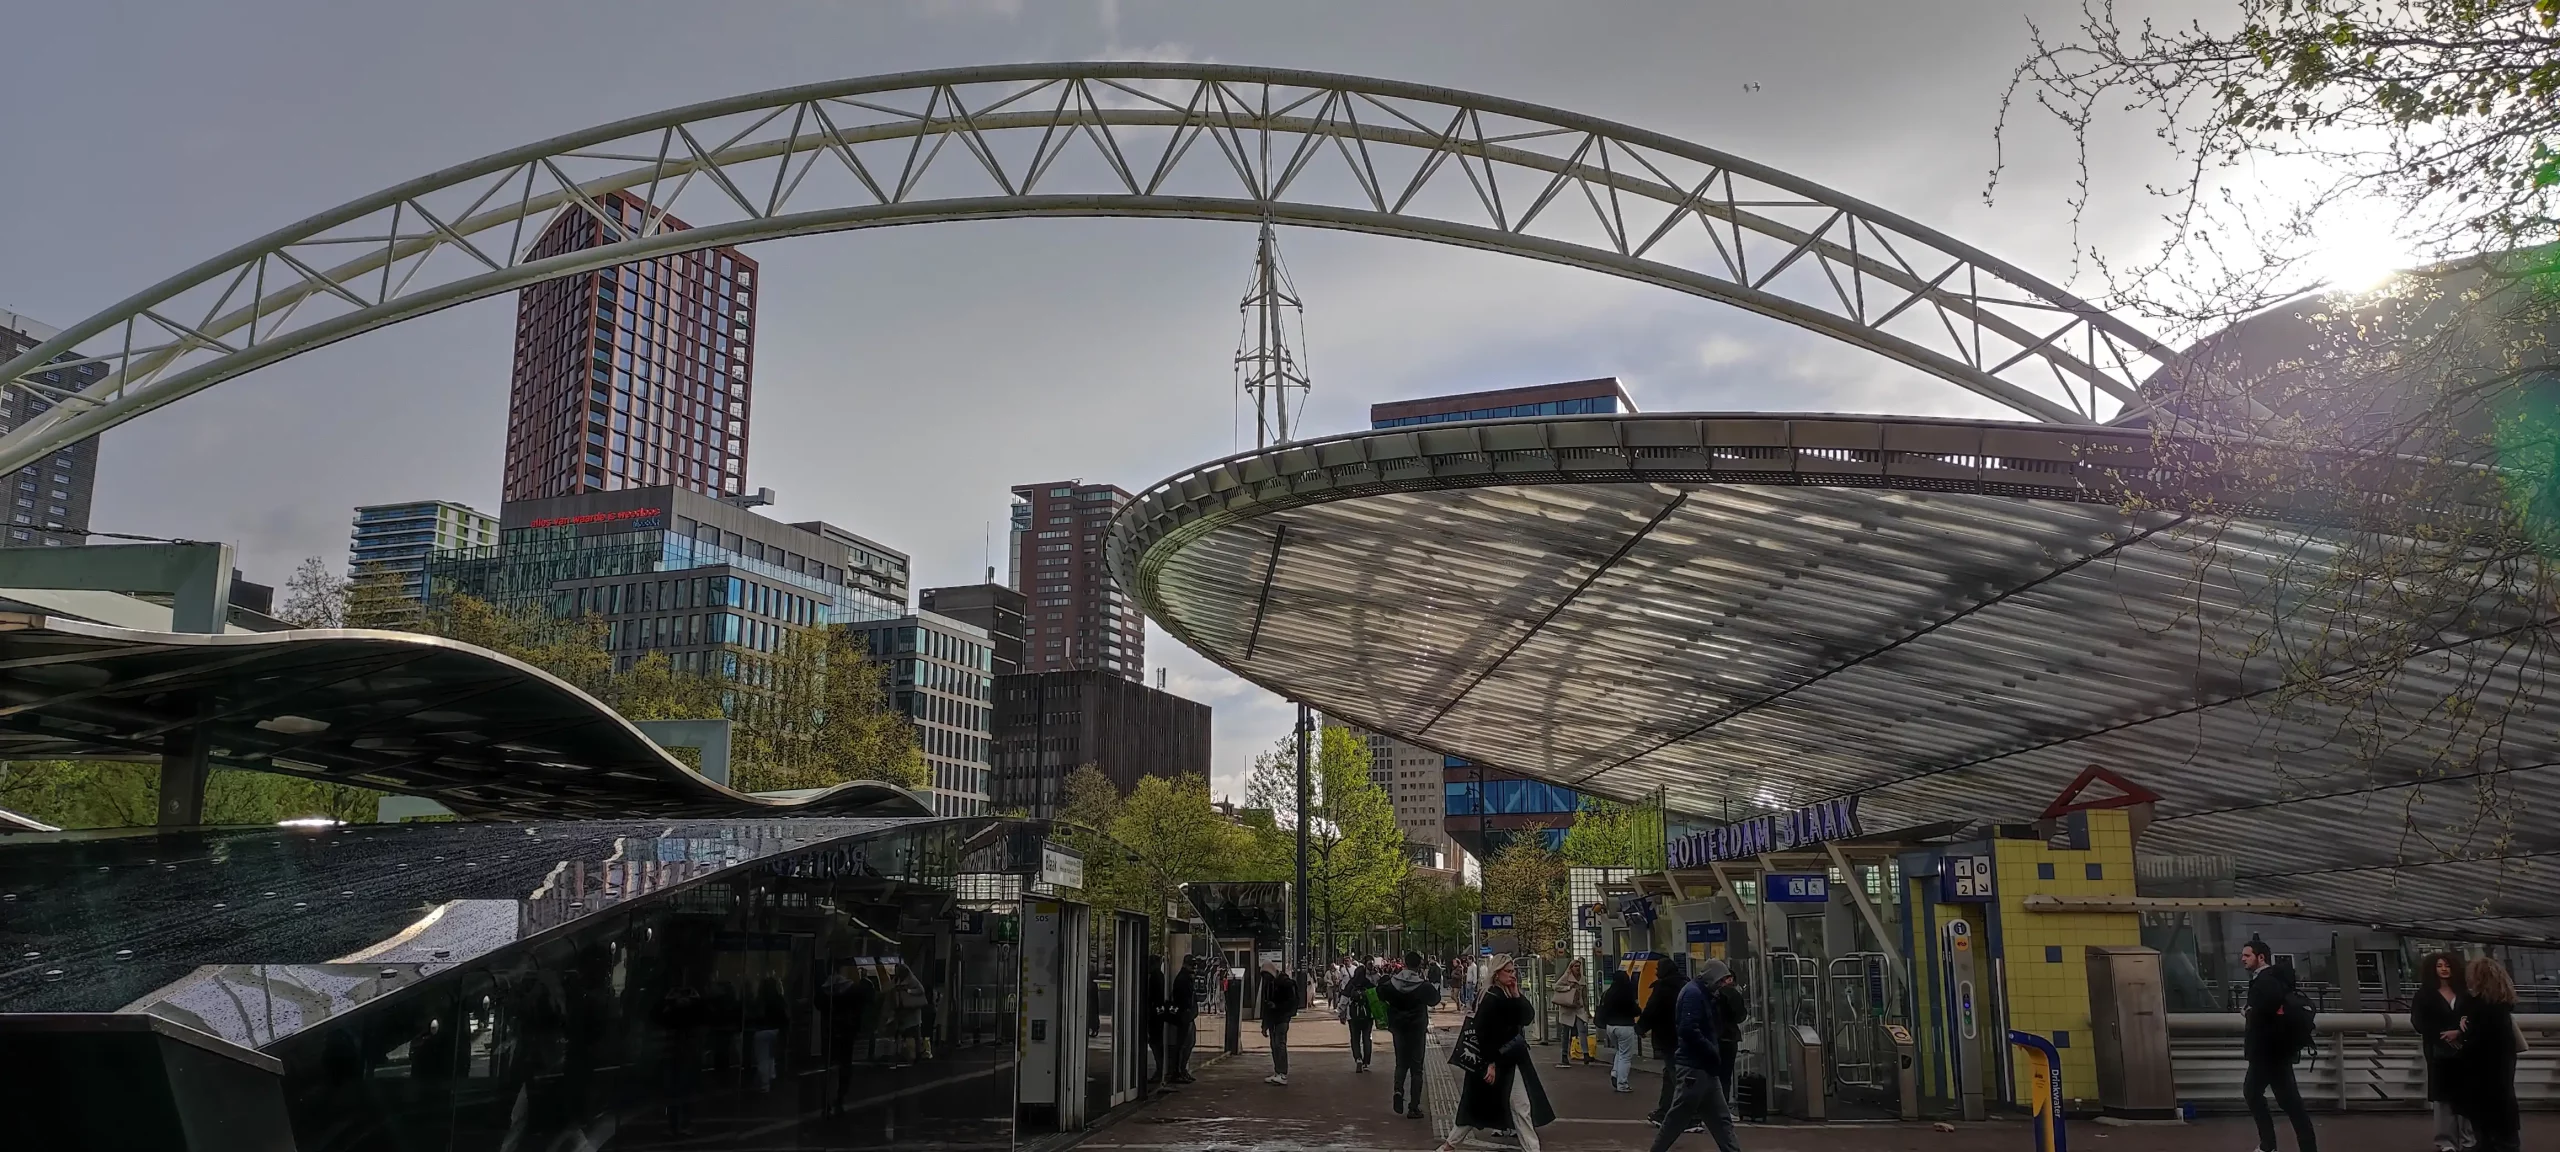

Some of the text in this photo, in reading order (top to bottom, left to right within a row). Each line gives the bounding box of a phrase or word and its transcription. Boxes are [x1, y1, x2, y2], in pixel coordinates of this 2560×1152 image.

[553, 517, 569, 525] van
[573, 513, 604, 523] waarde
[1667, 797, 1856, 870] ROTTERDAM BLAAK
[1045, 853, 1058, 873] Blaak
[1959, 865, 1966, 876] 1
[1961, 884, 1968, 895] 2
[2051, 1069, 2062, 1119] Drinkwater
